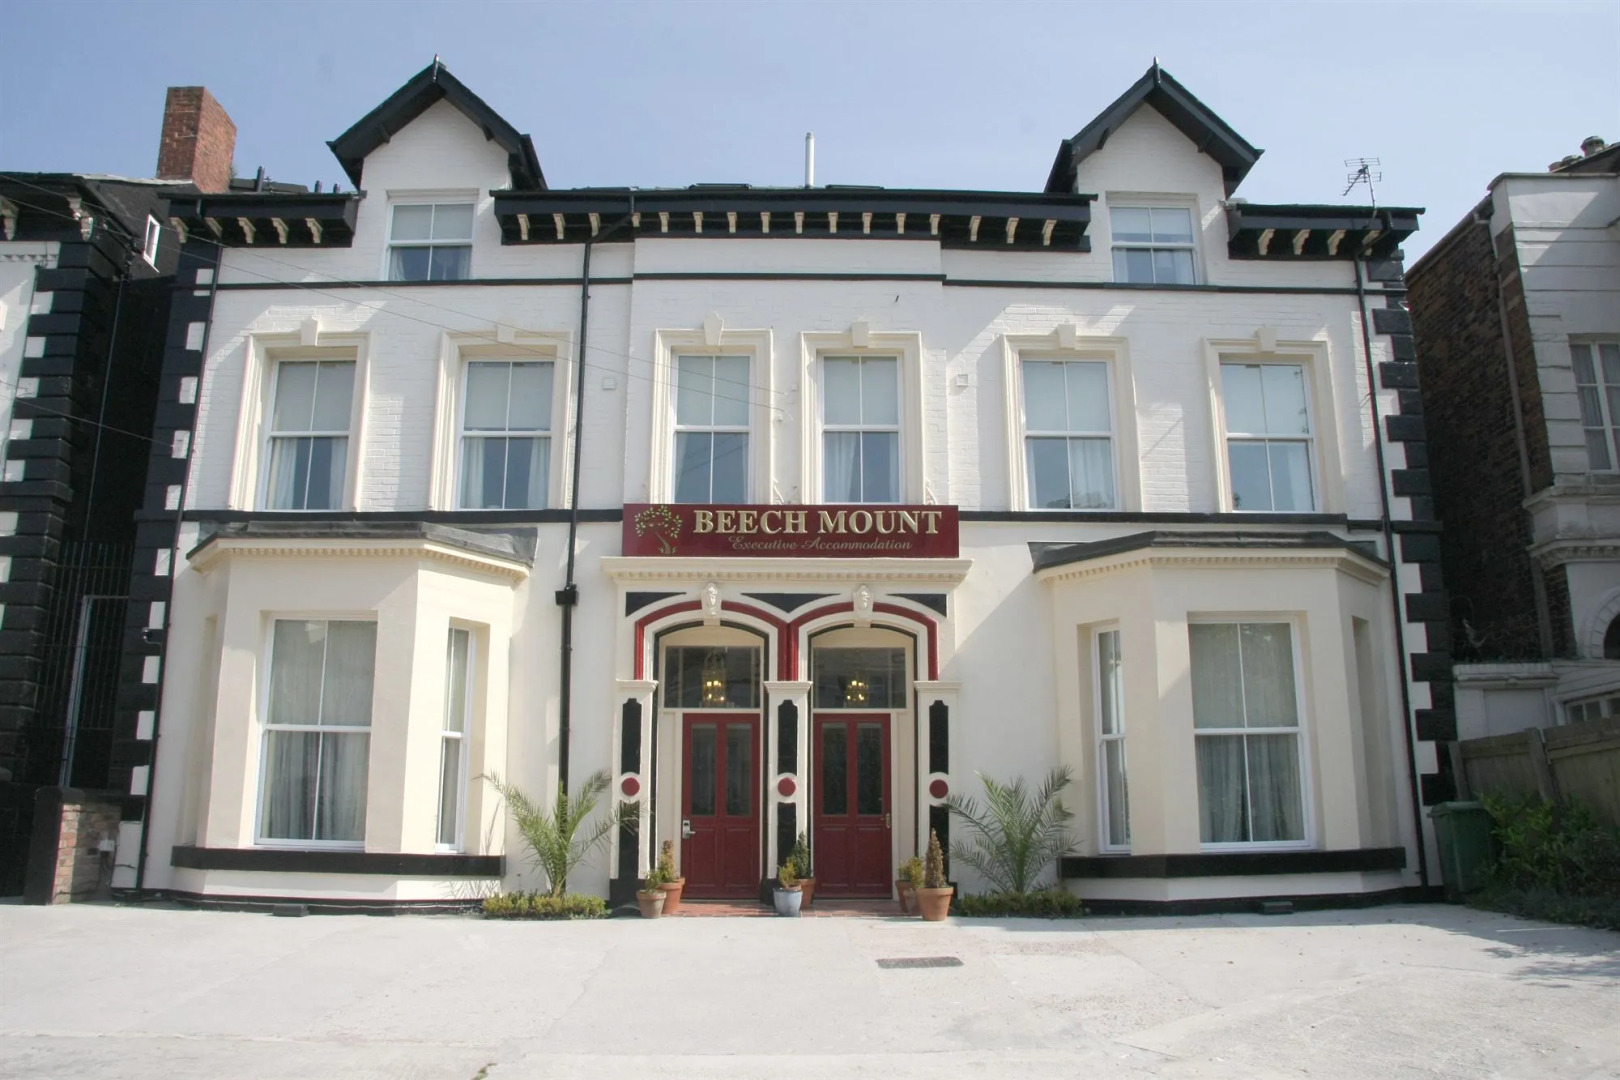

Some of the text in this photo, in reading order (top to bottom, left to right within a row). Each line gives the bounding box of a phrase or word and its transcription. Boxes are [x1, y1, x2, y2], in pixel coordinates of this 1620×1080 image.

[693, 510, 942, 534] BEECH MOUNT
[728, 535, 912, 550] Executive Accommodation
